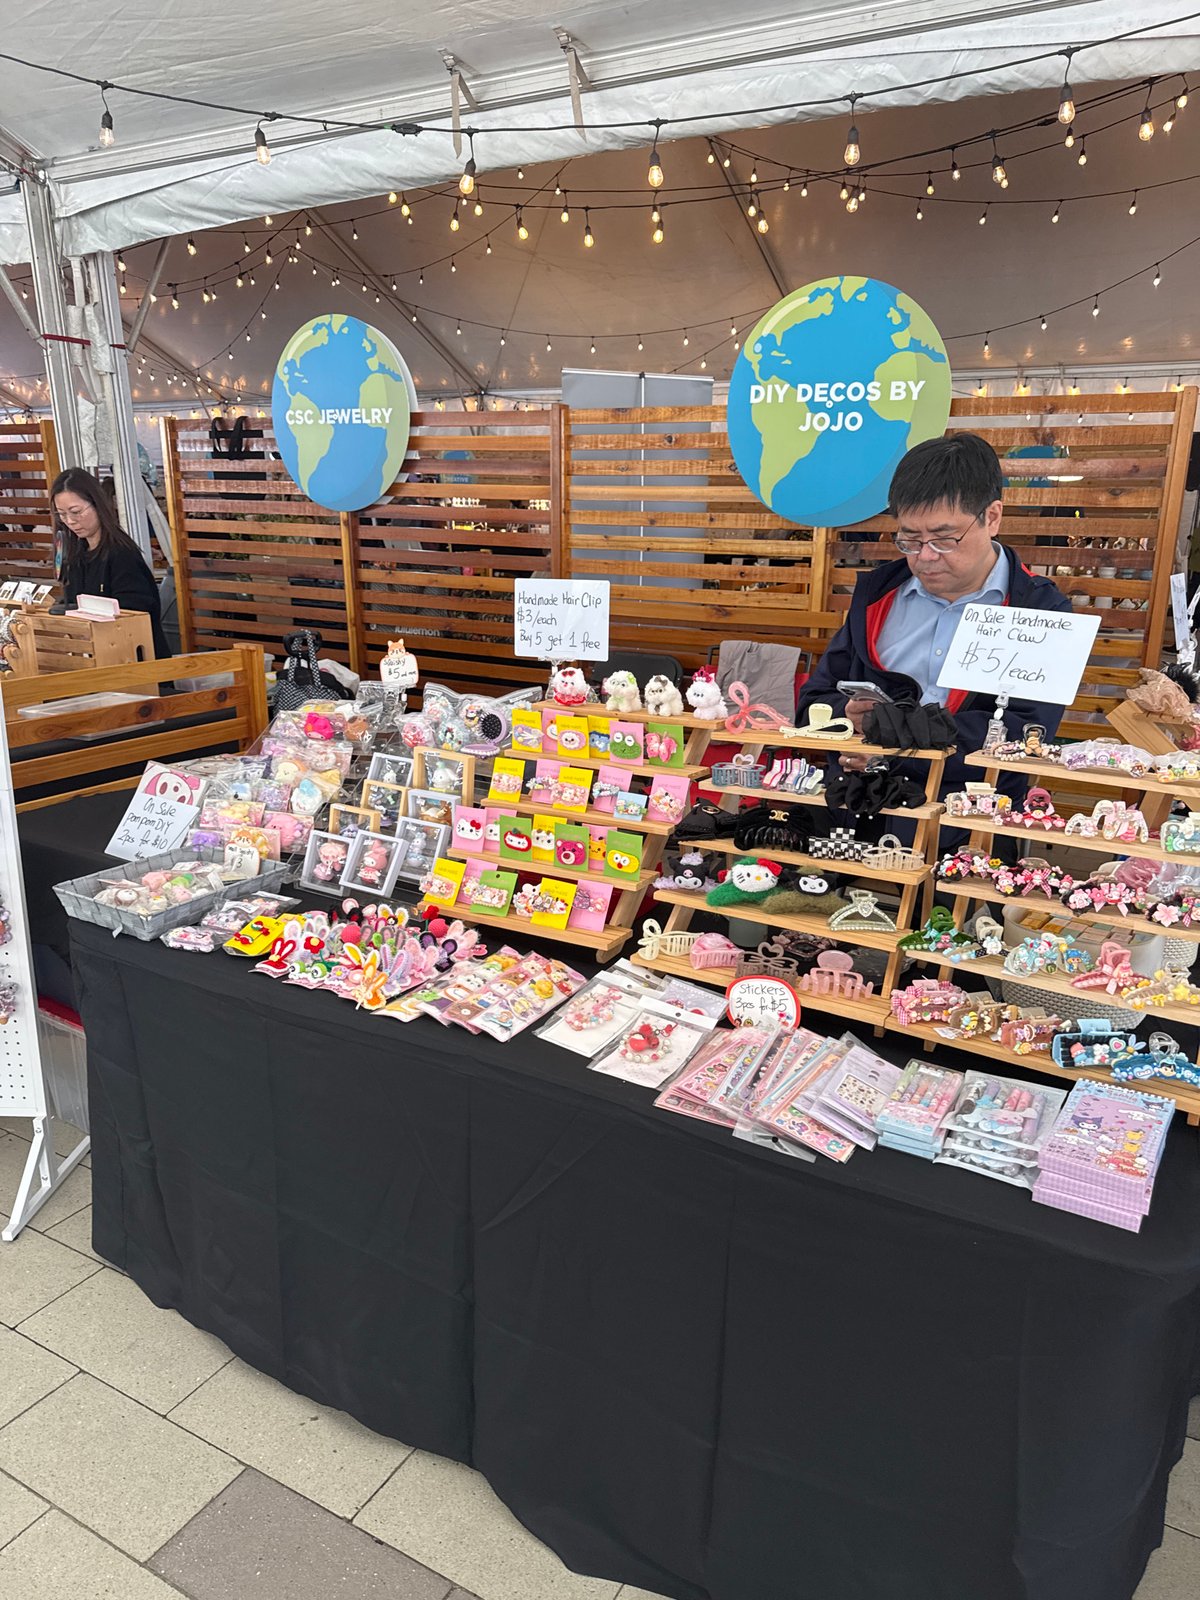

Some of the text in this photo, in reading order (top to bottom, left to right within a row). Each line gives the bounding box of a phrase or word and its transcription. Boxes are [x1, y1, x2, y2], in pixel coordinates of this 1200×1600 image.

[750, 380, 926, 404] DIY DECOS BY
[285, 408, 393, 425] CSC JEWELRY
[798, 411, 863, 432] JOJO
[518, 591, 602, 609] Handmade Hair Clip
[964, 607, 1073, 631] On Sale Handmade
[519, 629, 601, 653] Buy 5 get 1 free
[976, 625, 1048, 644] Hair Claw
[143, 797, 177, 817] On Sale
[151, 834, 169, 850] $10
[739, 983, 786, 996] Stickers
[735, 997, 755, 1012] 3pcs
[768, 996, 789, 1013] $5
